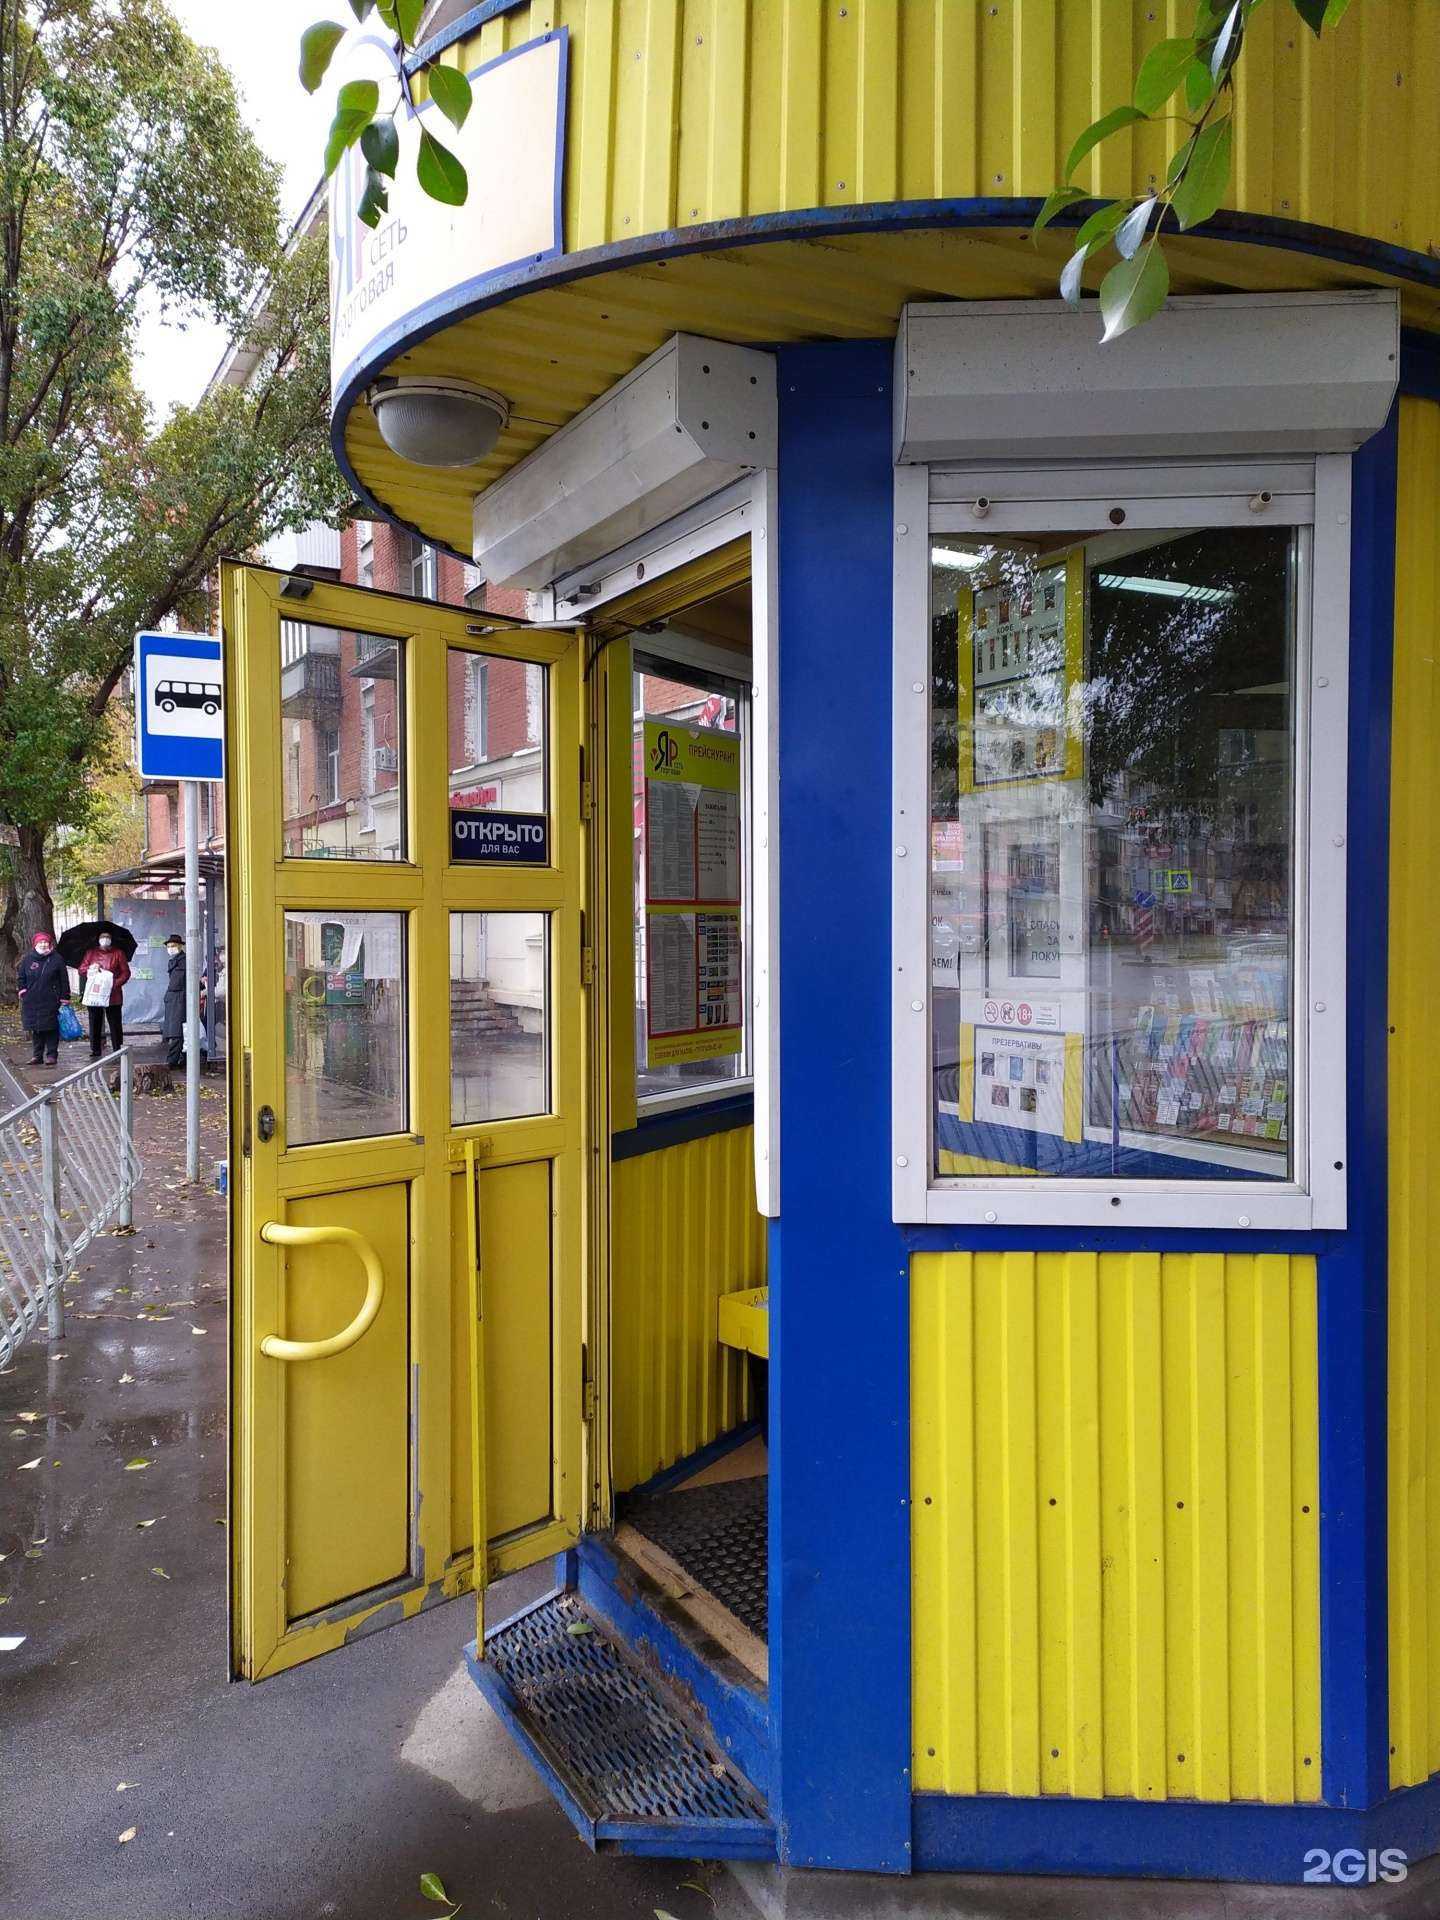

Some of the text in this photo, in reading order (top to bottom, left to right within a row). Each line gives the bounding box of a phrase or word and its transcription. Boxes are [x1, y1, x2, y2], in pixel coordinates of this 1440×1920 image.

[370, 218, 408, 266] СЕТЬ
[688, 743, 736, 765] ПРЕЙСКУРАНТ
[454, 821, 544, 843] ОТКРЫТО
[481, 844, 520, 854] ДЛЯ ВАС
[992, 1036, 1043, 1051] ПРЕЗЕРВАТИВЫ
